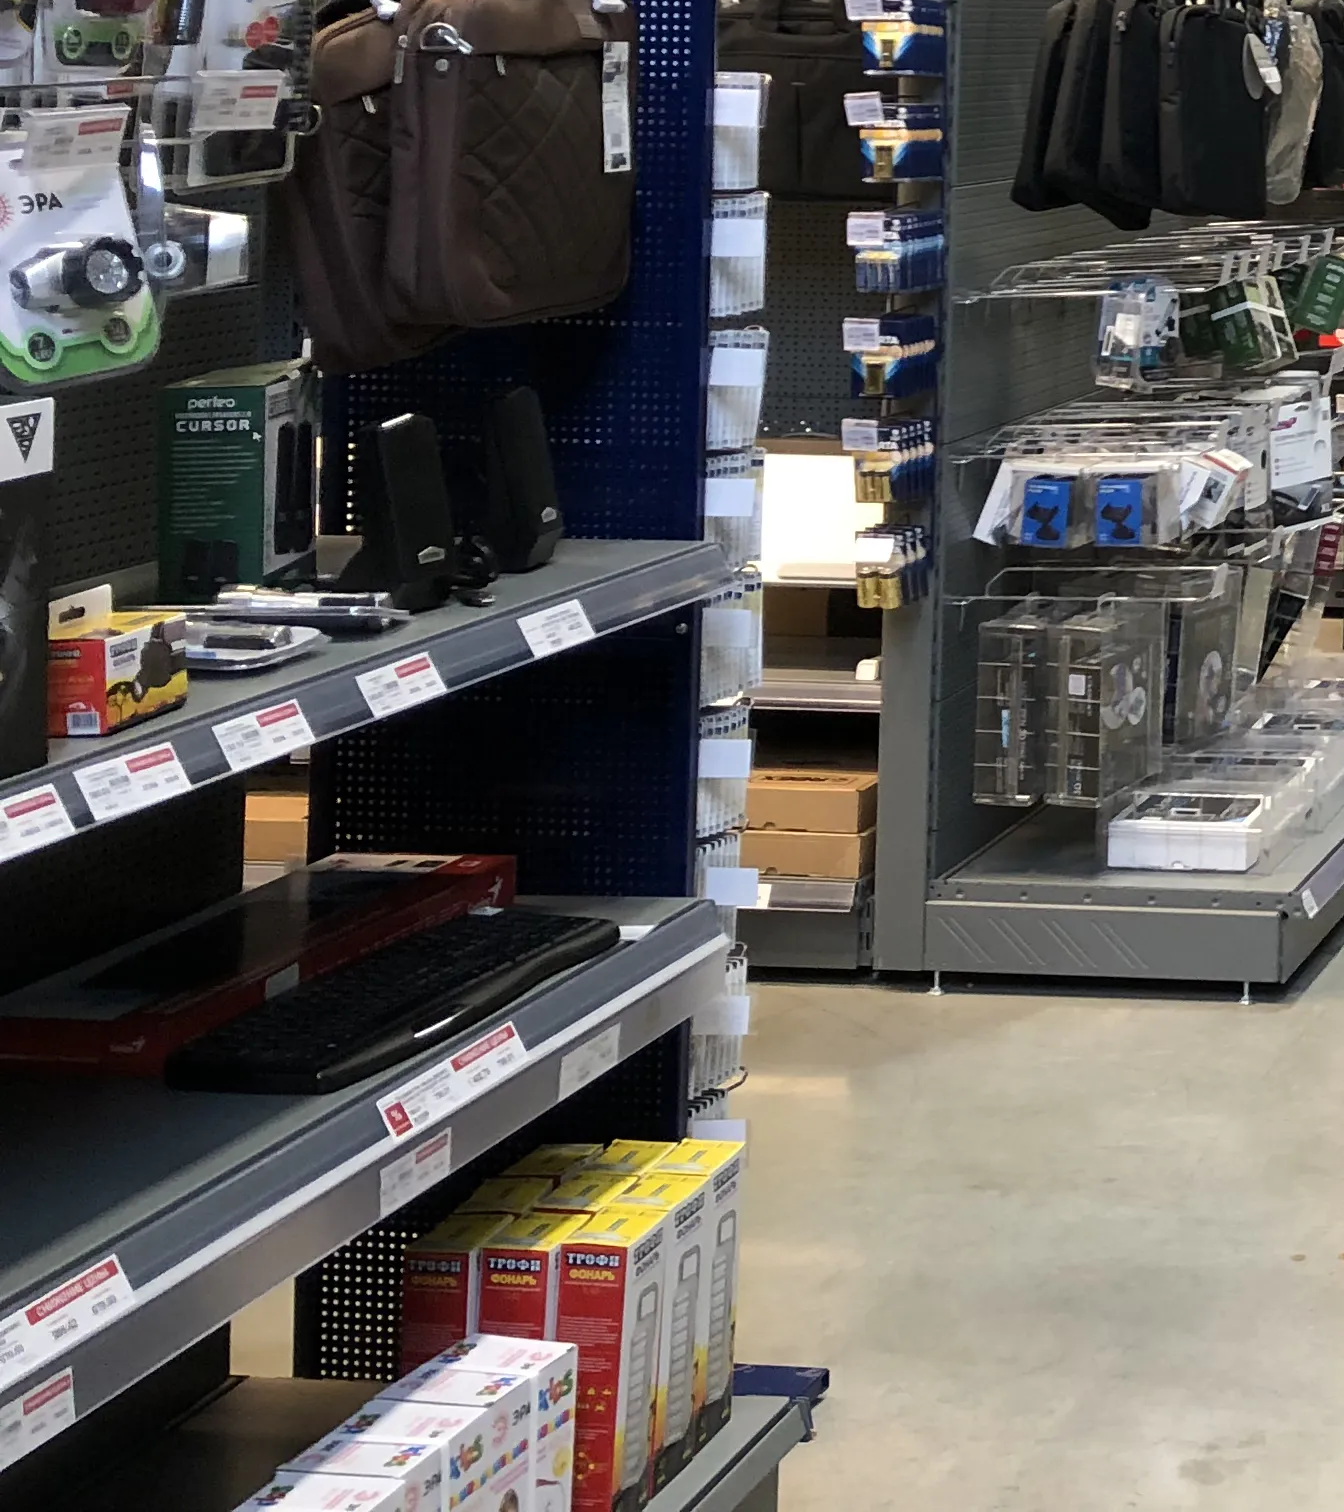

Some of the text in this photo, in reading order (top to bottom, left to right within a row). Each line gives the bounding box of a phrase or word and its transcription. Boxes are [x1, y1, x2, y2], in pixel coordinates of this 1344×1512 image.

[17, 192, 63, 214] ЭРА
[187, 395, 236, 410] perfeo
[175, 419, 250, 433] CURSOR
[487, 1256, 542, 1273] ТРОФИ
[566, 1252, 621, 1268] ТРОФИ
[490, 1272, 537, 1286] ФОНАРЬ
[568, 1268, 616, 1281] ФОНАРЬ
